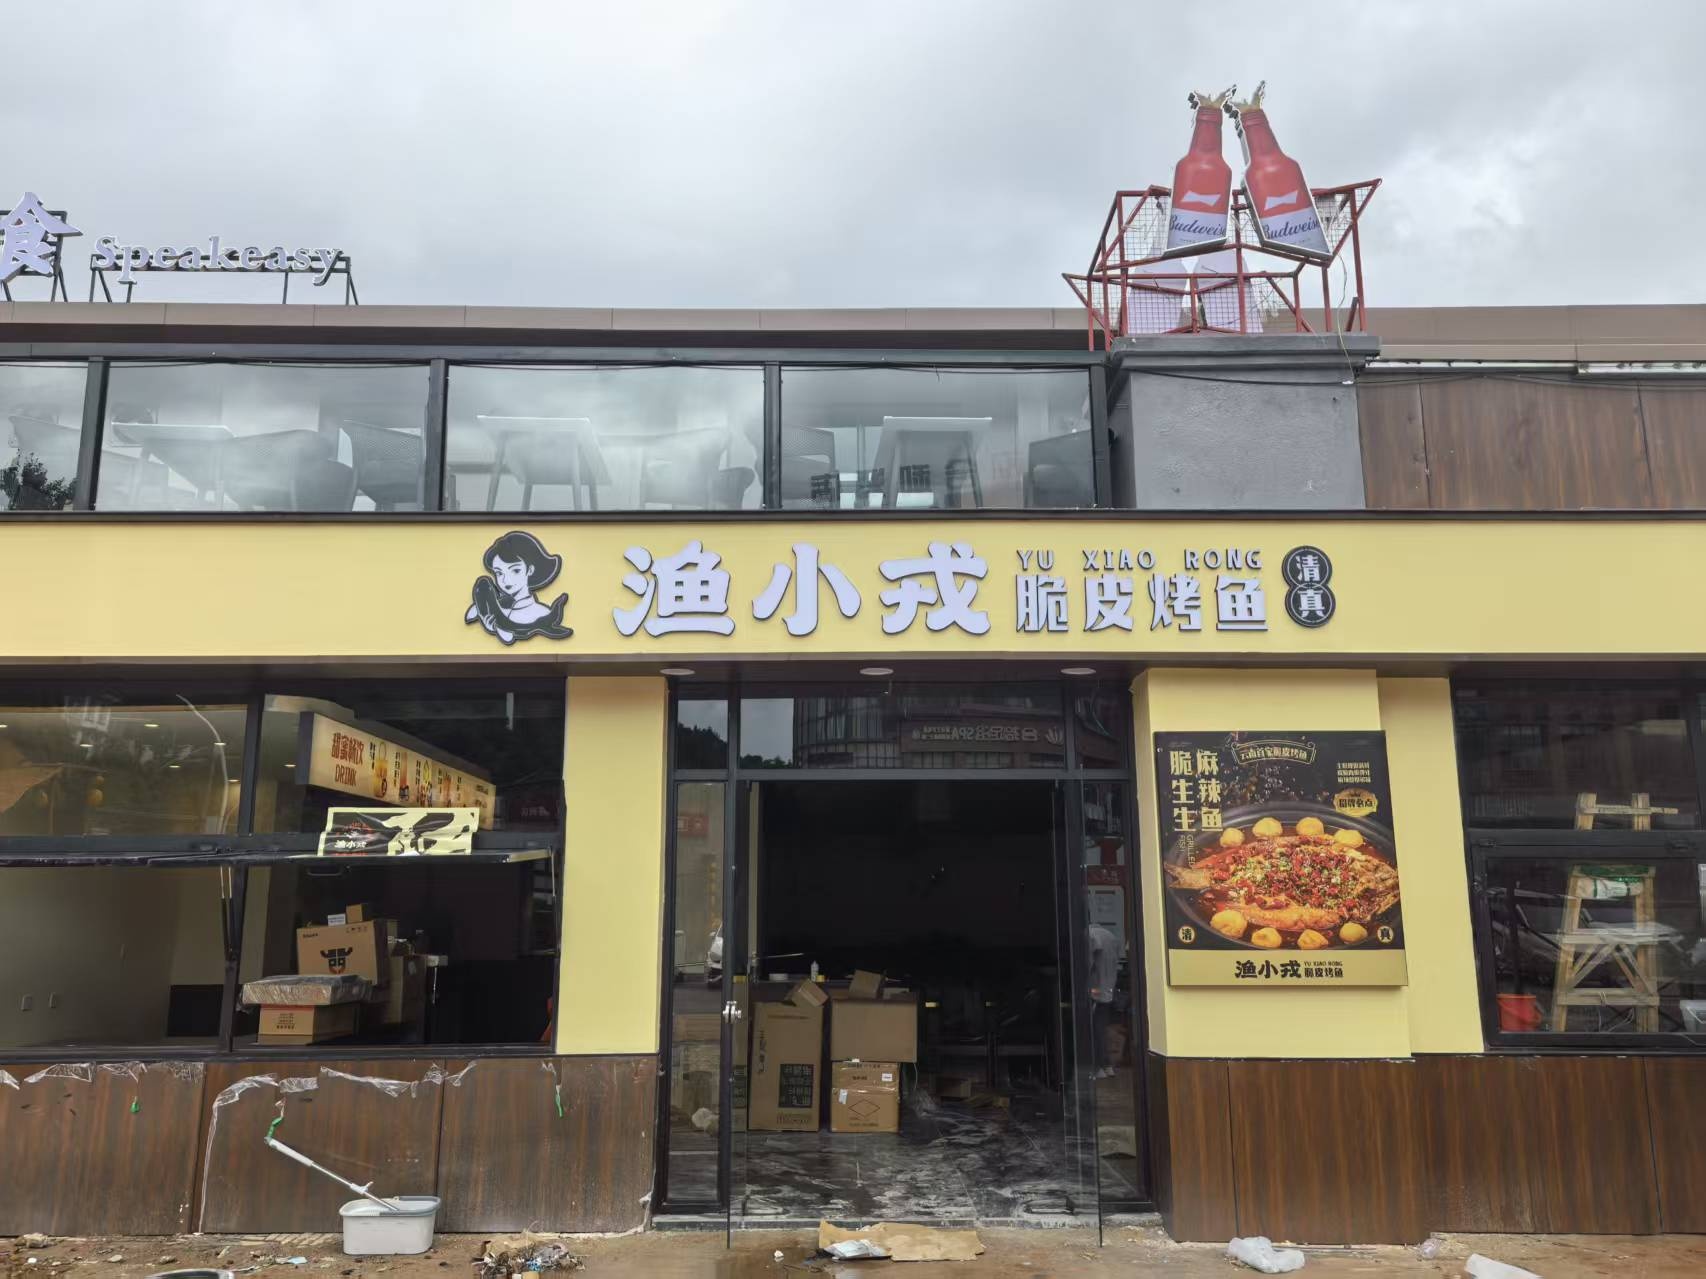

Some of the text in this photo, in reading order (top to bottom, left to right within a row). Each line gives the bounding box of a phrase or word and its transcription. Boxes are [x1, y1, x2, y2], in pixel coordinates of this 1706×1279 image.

[94, 235, 343, 286] Speakeasy
[1016, 549, 1262, 571] YU XIAO RONG
[1295, 554, 1326, 616] 清真
[612, 541, 991, 637] 渔小戎
[1016, 574, 1268, 632] 脆皮烤鱼
[335, 763, 357, 787] DRINK
[1169, 749, 1196, 832] 脆生生
[1196, 748, 1223, 832] 麻辣鱼
[1234, 960, 1302, 979] 渔小戎
[1304, 967, 1343, 978] 脆皮烤鱼
